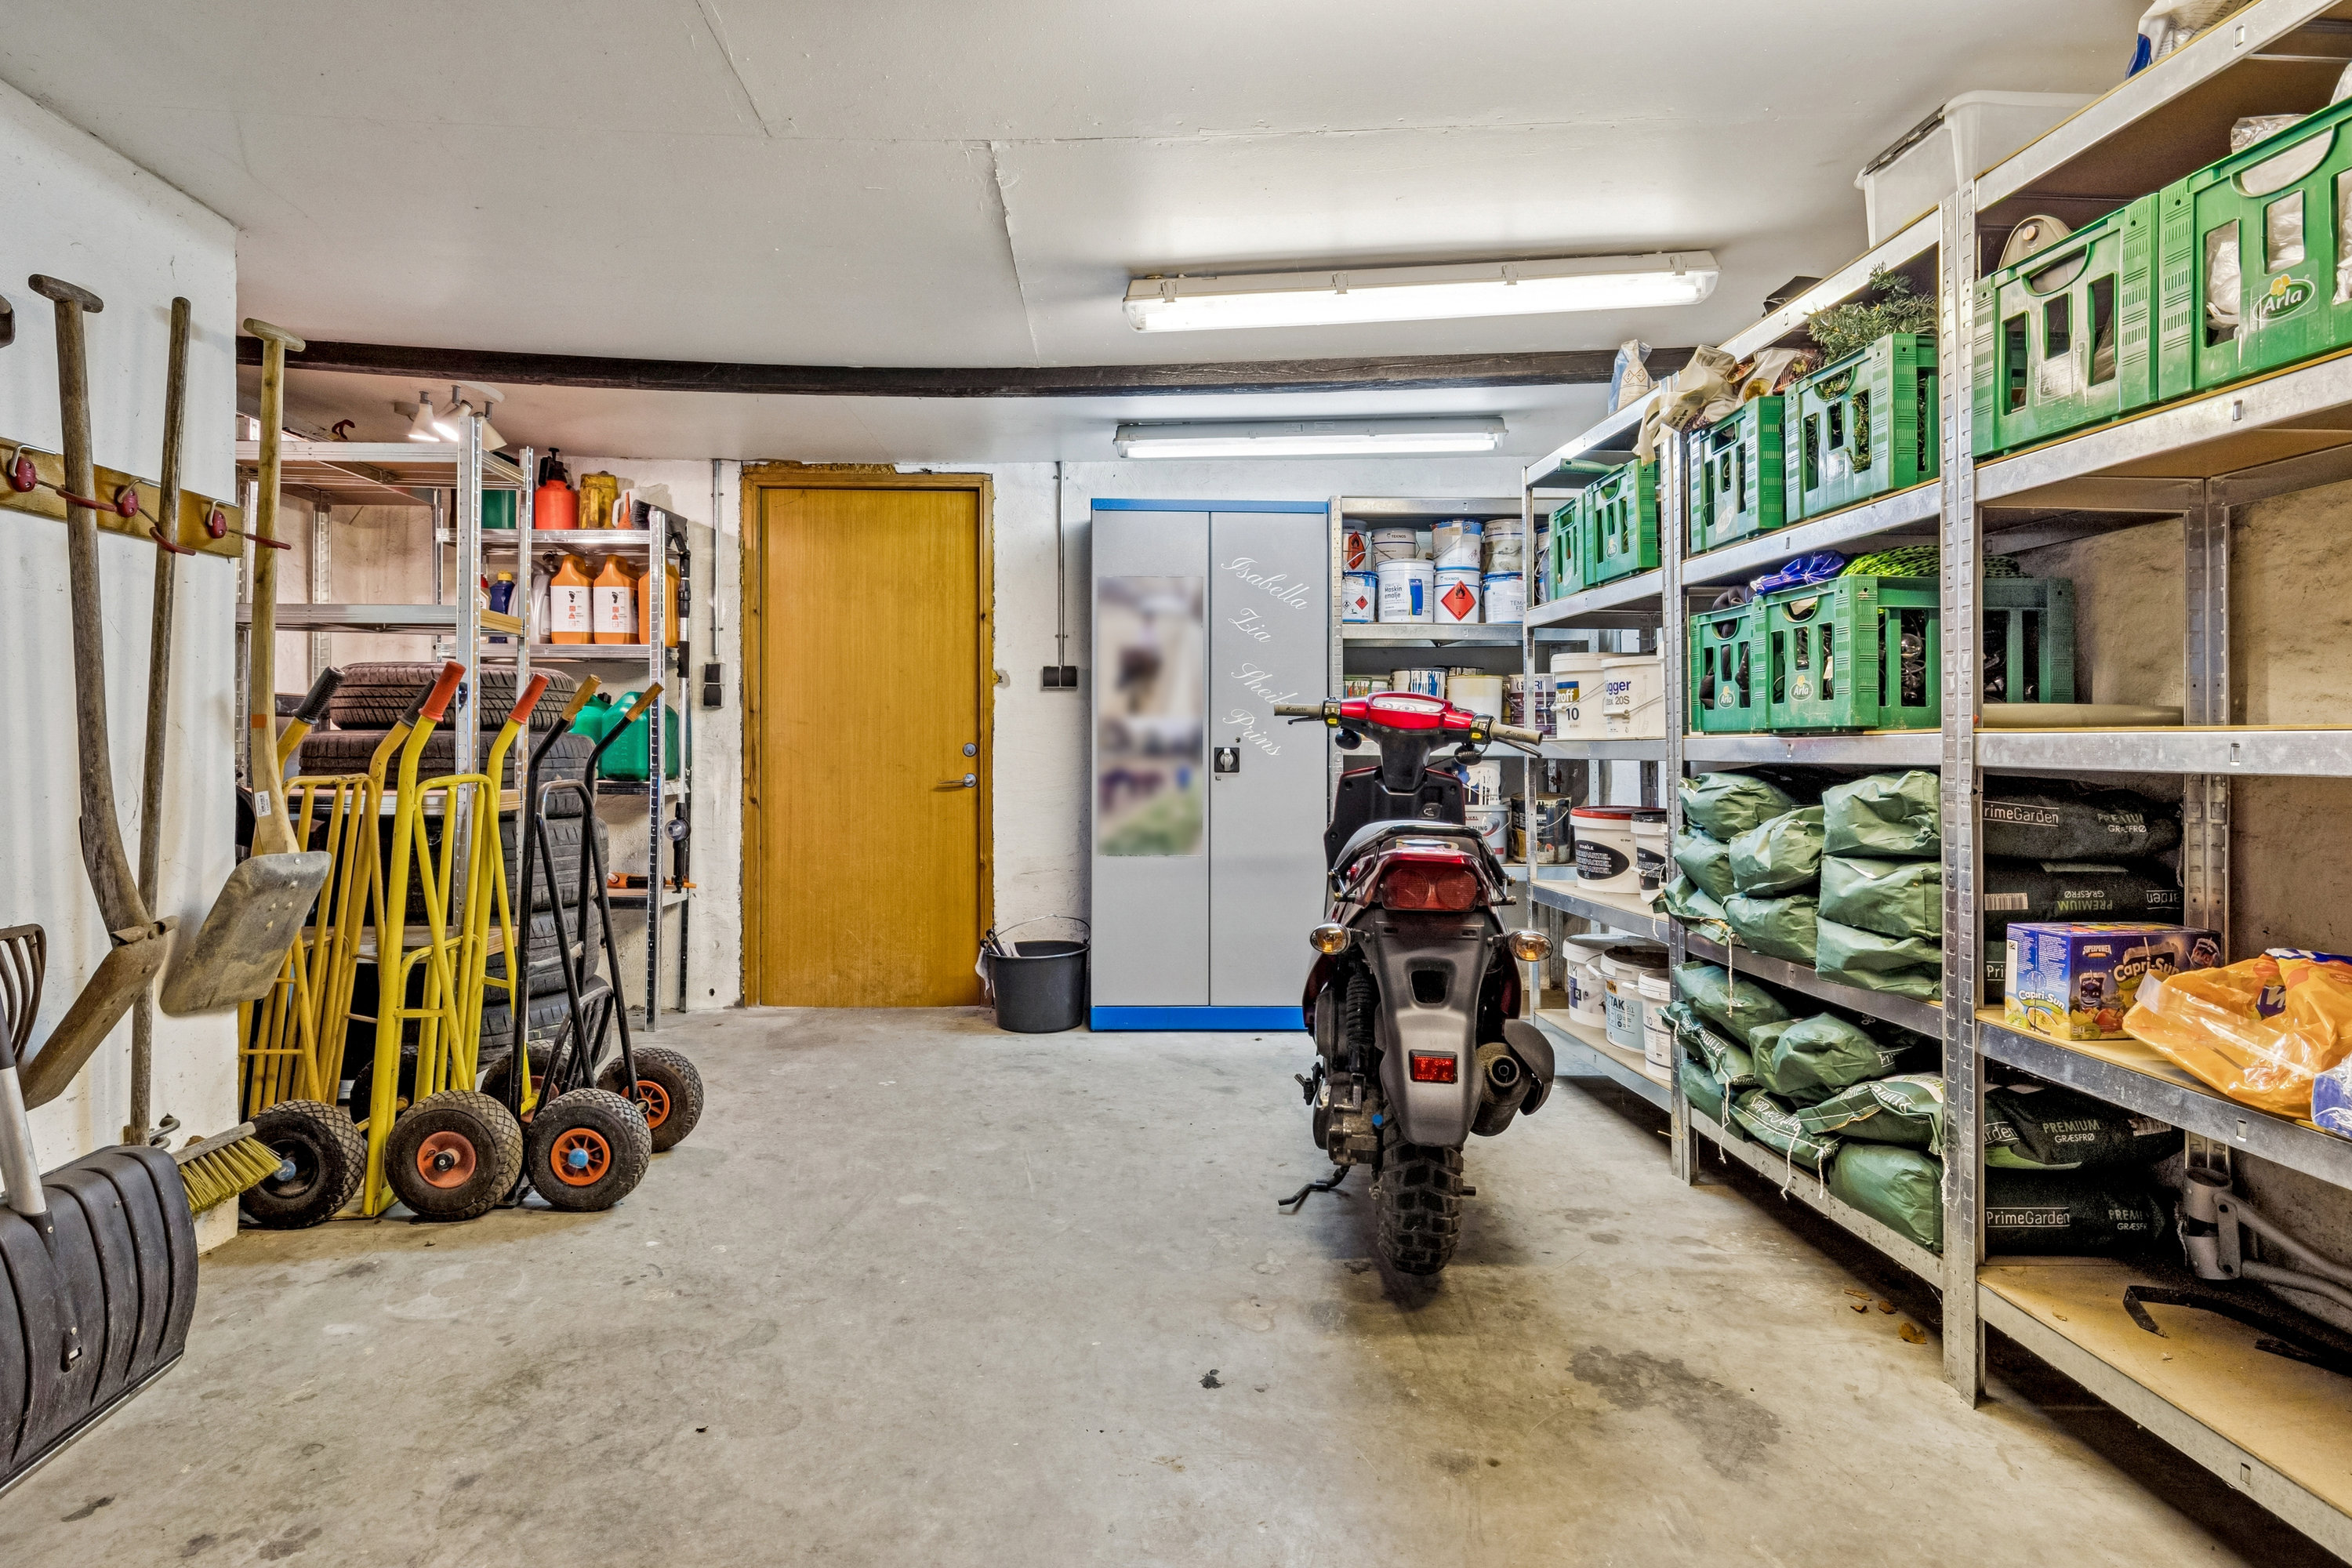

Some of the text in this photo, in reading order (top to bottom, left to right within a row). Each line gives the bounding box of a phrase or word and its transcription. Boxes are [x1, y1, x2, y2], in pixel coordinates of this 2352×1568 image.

[2262, 289, 2303, 314] Arla
[1221, 557, 1309, 609] Isabella
[1228, 608, 1272, 642] Zia
[1793, 686, 1809, 696] Arla
[1615, 695, 1630, 705] 20S
[1720, 695, 1732, 704] Arla
[1566, 707, 1580, 720] 10
[1222, 708, 1281, 756] Prins
[1984, 805, 2059, 823] rimeGarden
[2056, 899, 2114, 911] PREMIUM
[2113, 956, 2180, 982] Capri-Sun
[2018, 989, 2066, 1010] Capri-Sun
[2042, 1119, 2100, 1134] PREMIUM
[1986, 1210, 2070, 1225] PrimeGarden
[2108, 1209, 2143, 1221] PREMI
[2117, 1221, 2148, 1231] GRÆSFR
